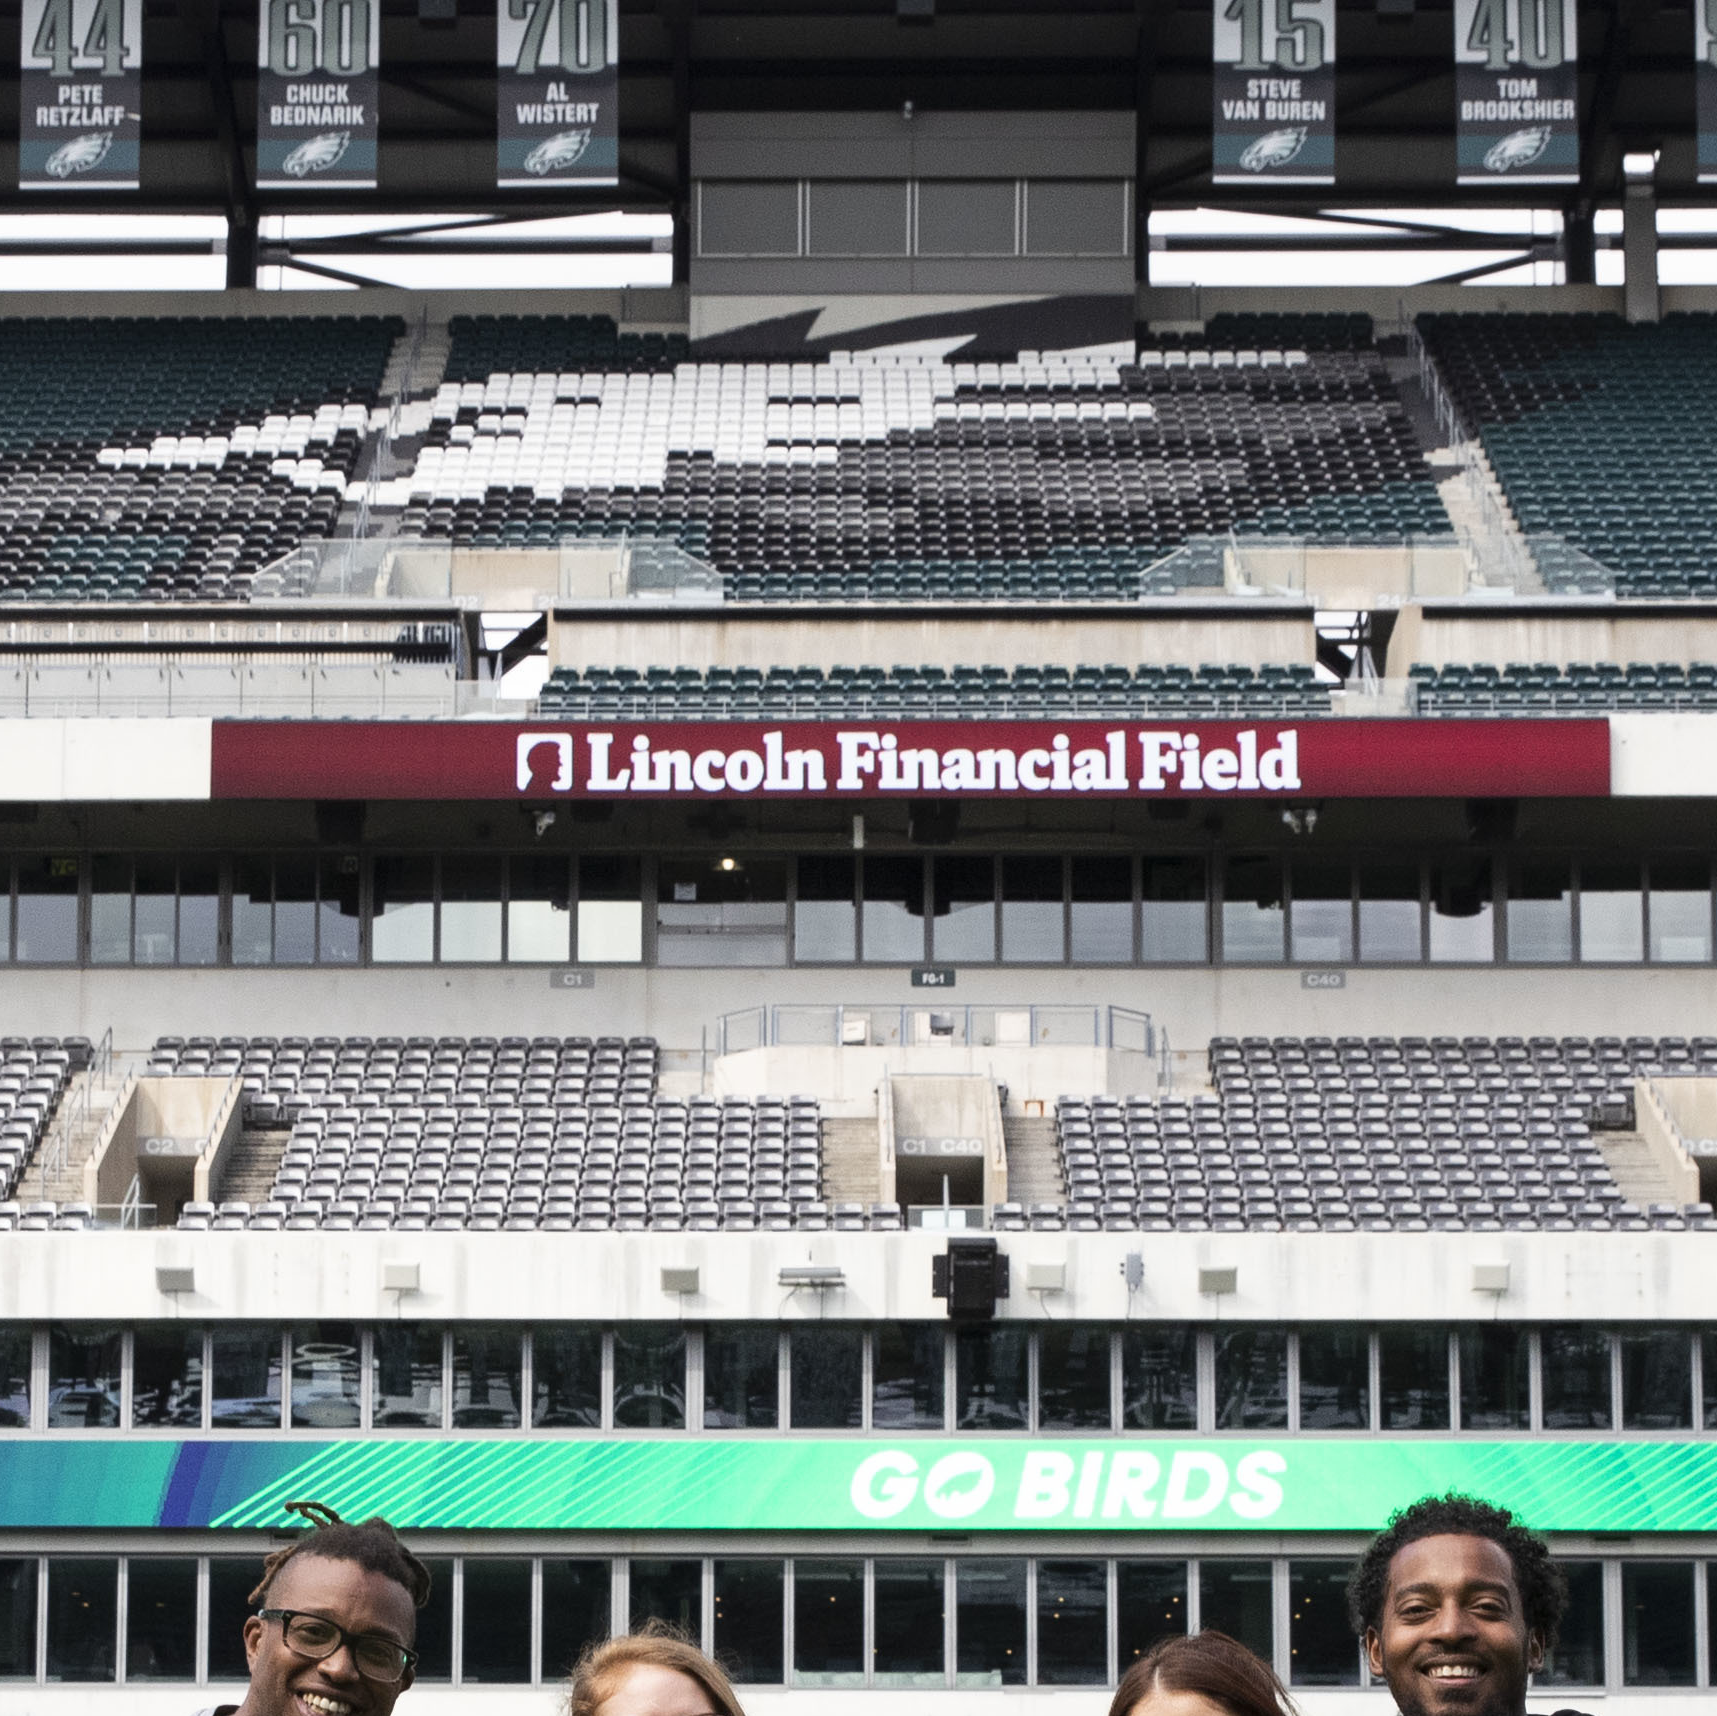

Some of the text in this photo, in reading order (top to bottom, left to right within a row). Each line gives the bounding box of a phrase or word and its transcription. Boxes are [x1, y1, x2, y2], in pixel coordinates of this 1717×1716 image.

[32, 0, 130, 77] 44
[268, 0, 370, 76] 60
[509, 0, 605, 75] 70
[1224, 0, 1325, 71] 15
[1467, 0, 1564, 71] 40
[58, 84, 103, 104] PETE
[286, 84, 349, 104] CHUCK
[546, 82, 569, 102] AL
[1247, 79, 1301, 98] STEVE
[1497, 79, 1537, 98] TOM
[36, 106, 125, 127] RETZLAFF
[270, 105, 365, 126] BEDNARIK
[517, 103, 600, 124] WISTERT
[1222, 100, 1326, 121] VAN BUREN
[1461, 100, 1575, 121] BROOKSHIER
[587, 729, 1301, 792] Lincoln Financial Field
[145, 1138, 174, 1155] C2
[903, 1138, 983, 1154] C1 C40
[850, 1449, 1288, 1519] GO BIRDS
